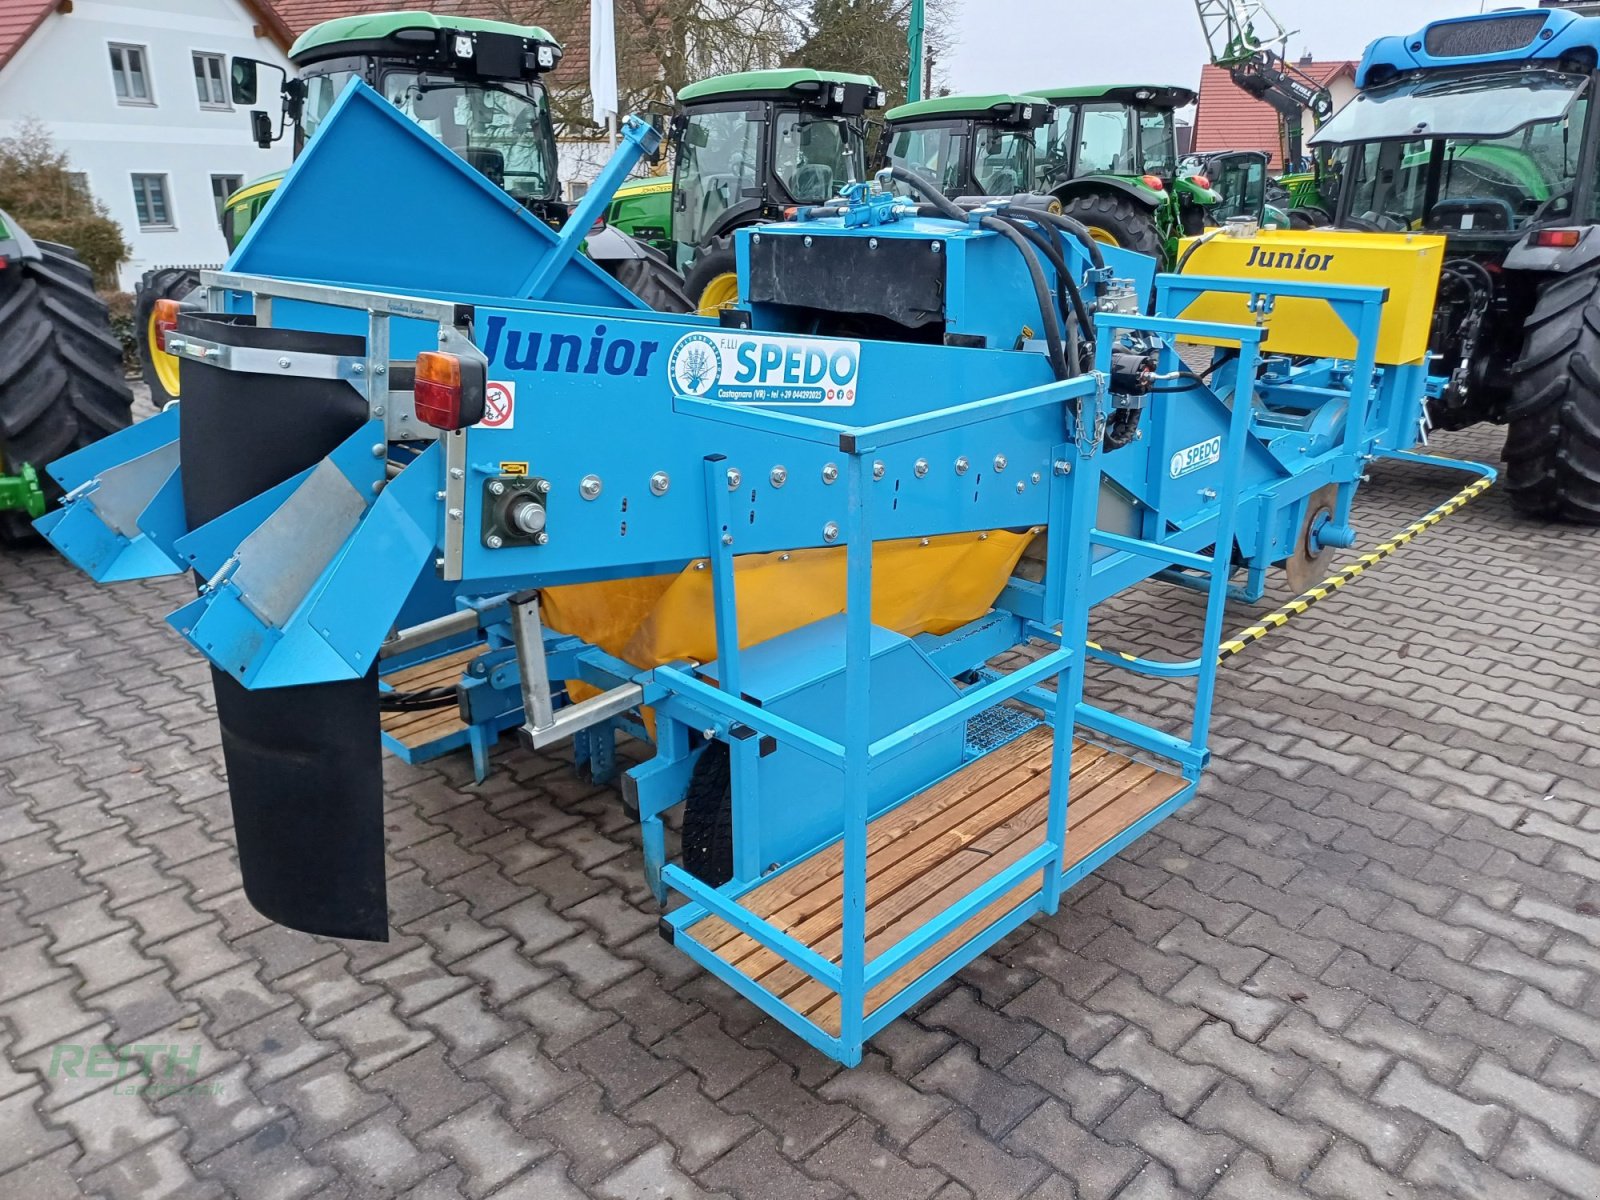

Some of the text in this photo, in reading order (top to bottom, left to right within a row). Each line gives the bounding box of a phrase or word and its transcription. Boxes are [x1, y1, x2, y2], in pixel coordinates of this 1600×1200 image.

[1246, 246, 1334, 271] Junior
[483, 315, 659, 377] Junior
[734, 341, 857, 386] SPEDO
[718, 388, 752, 401] Castagnaro
[753, 389, 766, 400] (VR)
[770, 390, 779, 399] tel
[1186, 438, 1219, 465] SPEDO
